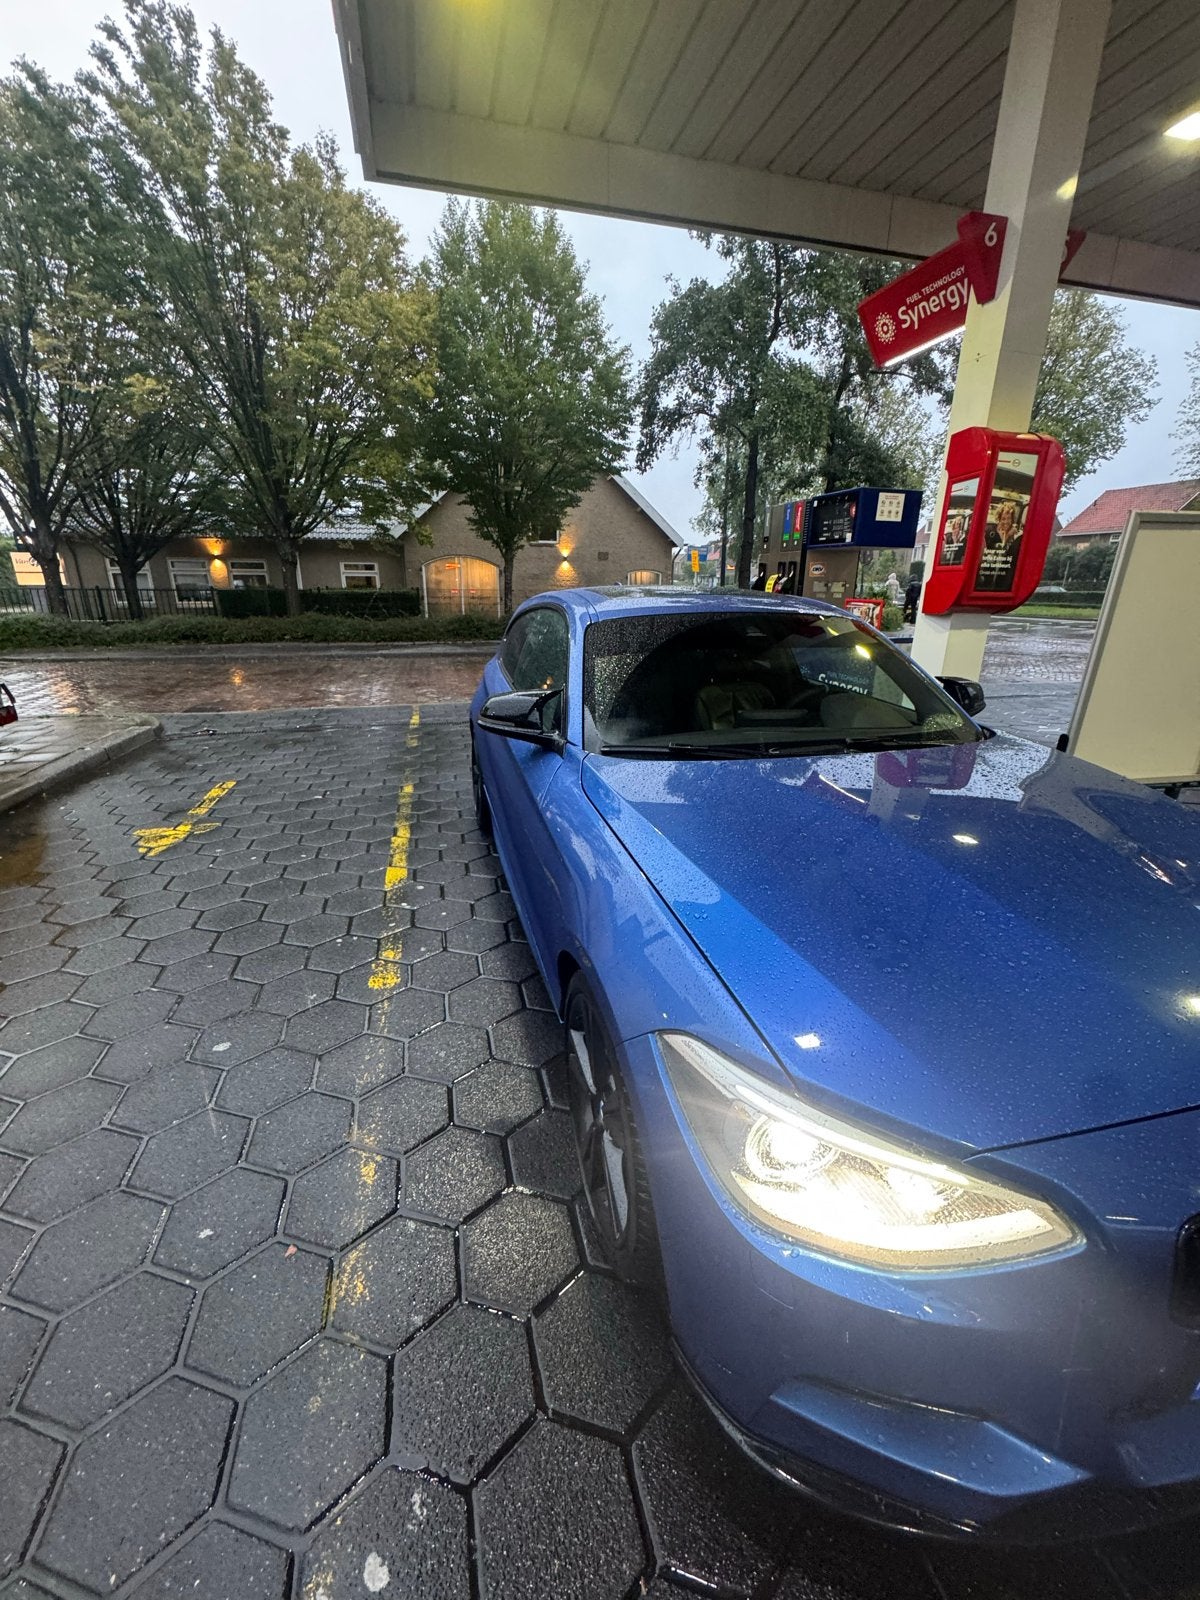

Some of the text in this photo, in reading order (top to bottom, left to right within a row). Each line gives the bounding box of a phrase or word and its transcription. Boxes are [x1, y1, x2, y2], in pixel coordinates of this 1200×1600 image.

[984, 222, 998, 247] 6
[897, 277, 969, 330] Synergy
[906, 265, 965, 305] FUEL TECHNOLOGY
